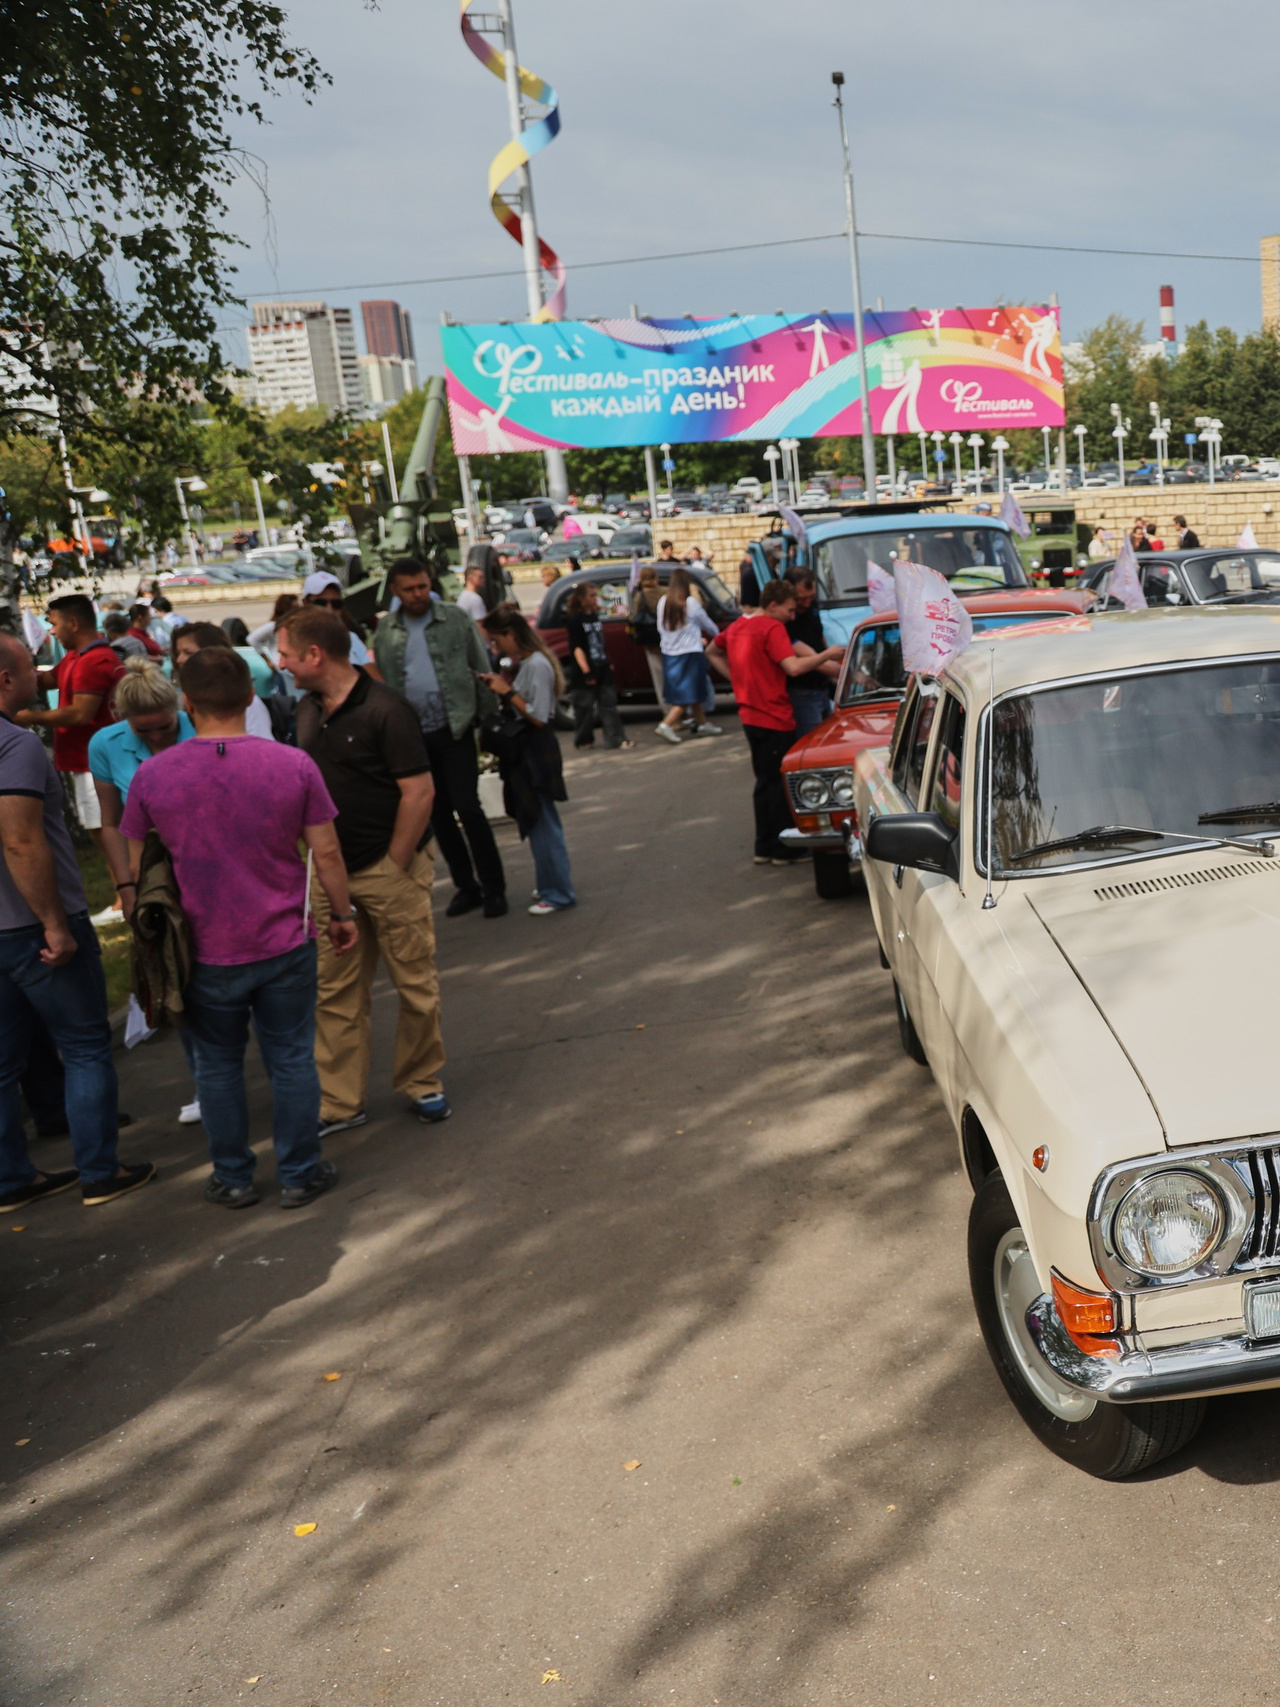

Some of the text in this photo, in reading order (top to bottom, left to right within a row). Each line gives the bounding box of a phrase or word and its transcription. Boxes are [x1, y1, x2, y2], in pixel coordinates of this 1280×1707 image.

[473, 340, 776, 394] Фестиваль-праздник
[551, 382, 746, 417] каждый день!
[940, 378, 1034, 413] Фестиваль
